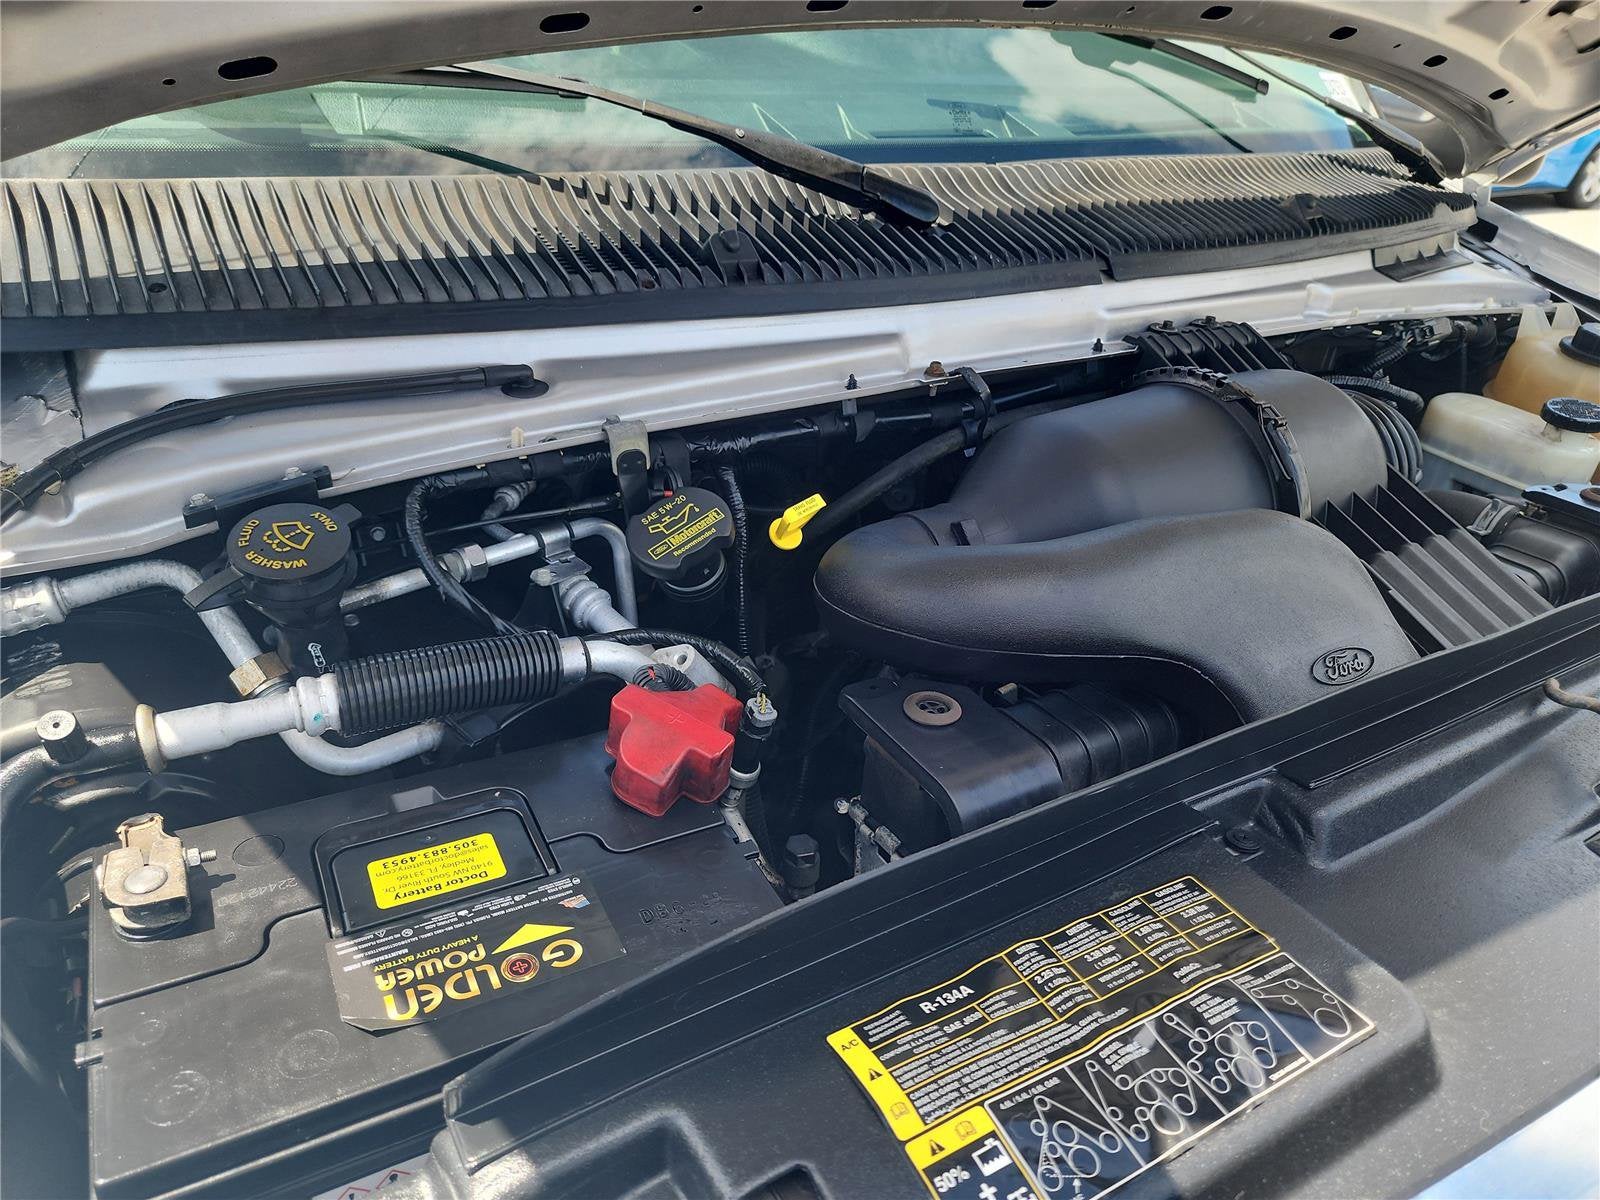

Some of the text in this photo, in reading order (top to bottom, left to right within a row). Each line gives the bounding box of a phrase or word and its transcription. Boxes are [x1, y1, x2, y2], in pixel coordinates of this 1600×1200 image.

[641, 494, 687, 525] SAE 5W-20
[238, 511, 338, 570] WASHER FLUID ONLY
[673, 528, 717, 556] Recommended
[1324, 651, 1365, 681] Ford
[376, 846, 487, 876] sales@doctorbattery.com
[380, 840, 477, 868] 305.883.4953
[440, 857, 474, 869] Medley,
[471, 861, 493, 870] 9140
[396, 870, 424, 881] 33166
[423, 872, 451, 883] South
[453, 867, 469, 876] NW
[395, 871, 488, 900] Doctor Battery
[399, 880, 421, 889] River
[1155, 883, 1185, 897] GASOLINE
[1109, 900, 1141, 916] GASOLINE
[1065, 922, 1092, 936] DIESEL
[442, 938, 471, 951] HEAVY
[416, 947, 440, 959] DUTY
[373, 955, 414, 972] BATTERY
[373, 945, 486, 991] POWER
[920, 986, 974, 1013] R-134A
[943, 1021, 964, 1033] SAE
[840, 1038, 859, 1052] A/C
[933, 1165, 971, 1193] 50%
